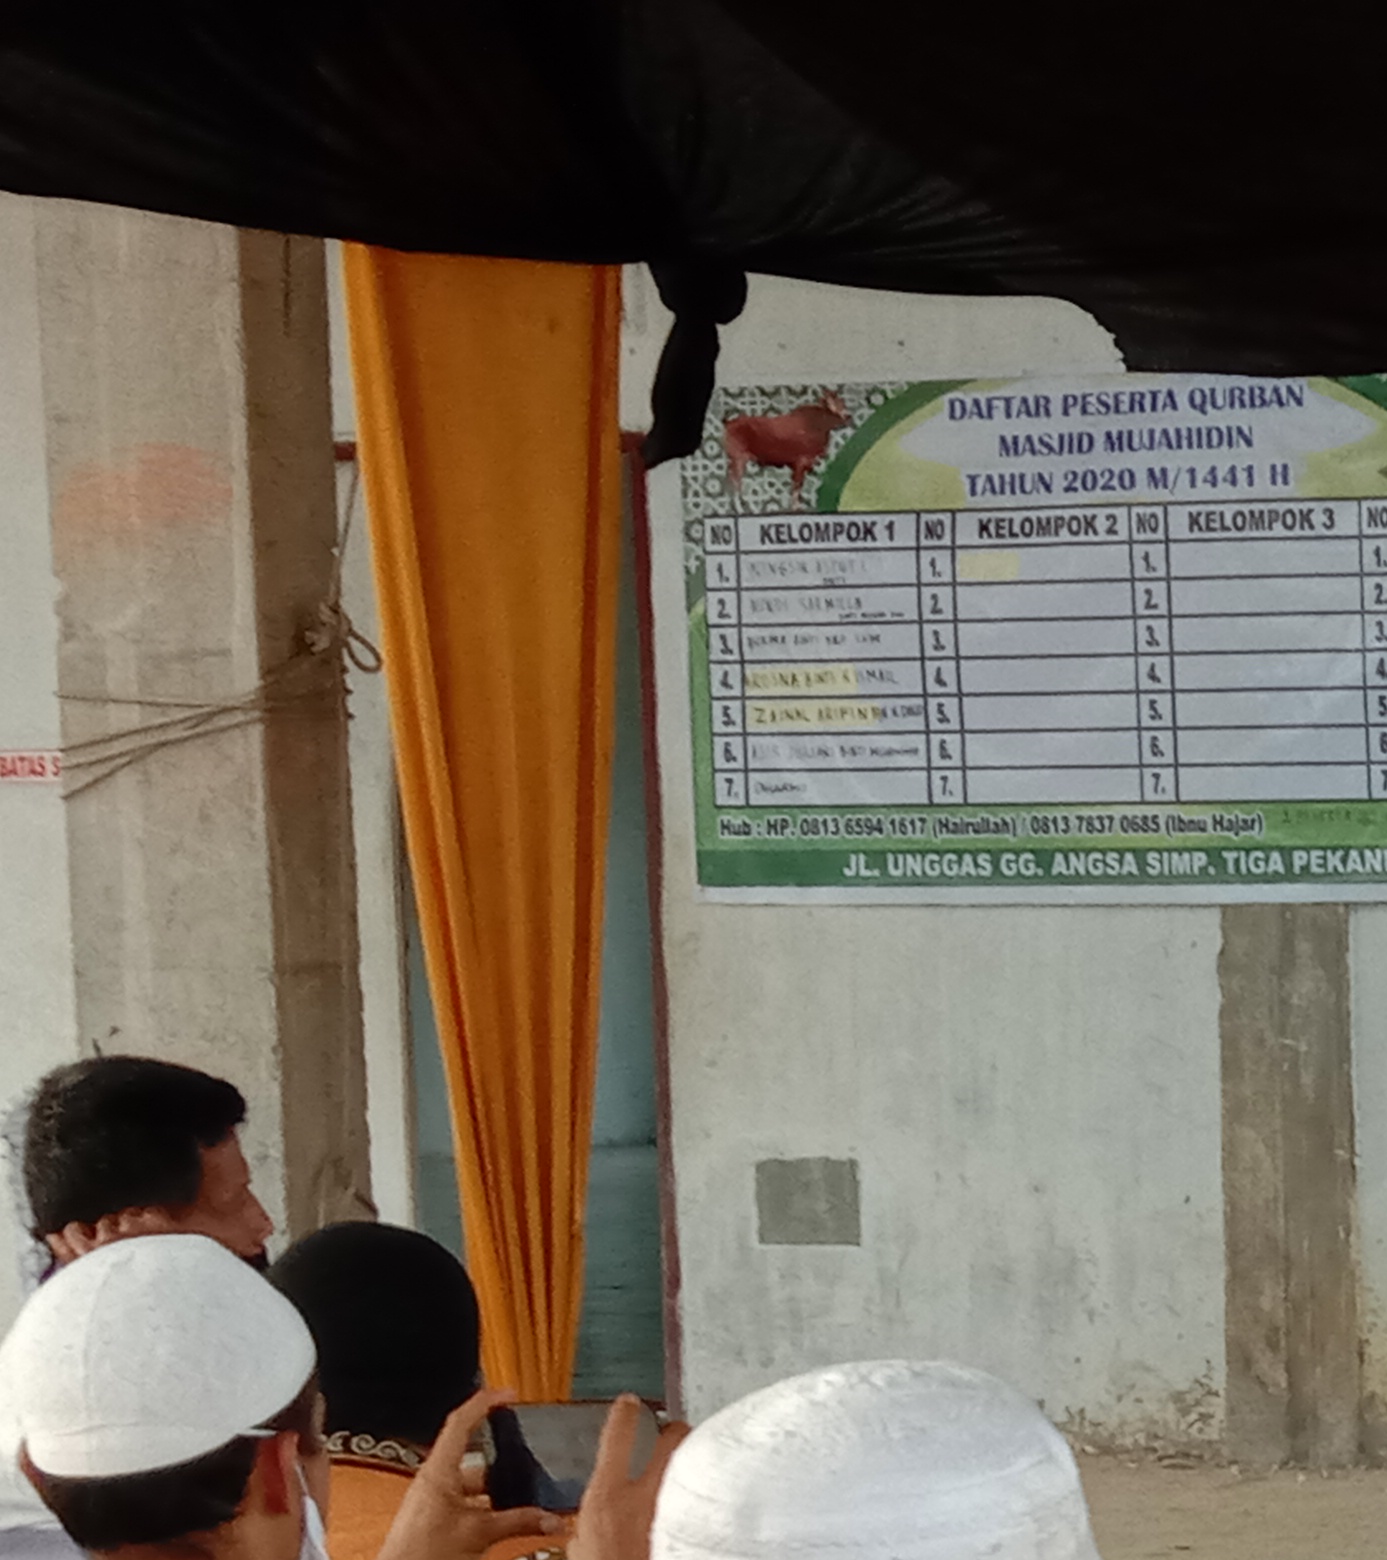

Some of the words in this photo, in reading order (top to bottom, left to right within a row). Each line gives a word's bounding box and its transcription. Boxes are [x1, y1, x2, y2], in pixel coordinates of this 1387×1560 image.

[948, 395, 1051, 420] DAFTAR
[1062, 388, 1179, 416] PESERTA
[1188, 385, 1303, 412] QURBAN
[999, 432, 1094, 457] MASJID
[1104, 426, 1253, 455] MUJAHIDIN
[966, 472, 1053, 497] TAHUN
[1063, 467, 1135, 493] 2020
[1147, 464, 1255, 495] M/1441
[1270, 463, 1290, 486] H
[924, 519, 945, 542] NO
[978, 513, 1098, 539] KELOMPOK
[1105, 512, 1119, 535] 2
[1135, 512, 1159, 536] NO
[1188, 509, 1315, 533] KELOMPOK
[1322, 508, 1336, 529] 3
[711, 524, 732, 545] NO
[760, 520, 878, 545] KELOMPOK
[885, 520, 895, 541] 1
[929, 557, 942, 578] 1.
[1142, 551, 1156, 573] 1.
[1373, 546, 1387, 568] 1.
[717, 562, 729, 582] 1.
[724, 778, 739, 798] 7.
[940, 775, 953, 796] 7.
[1151, 772, 1166, 795] 7.
[720, 817, 751, 837] Hub
[800, 815, 838, 836] 0813
[844, 816, 883, 836] 6594
[931, 815, 1016, 839] (Hairullah)
[1031, 814, 1070, 835] 0813
[1076, 814, 1114, 835] 7837
[1119, 814, 1159, 835] 0685
[1165, 813, 1207, 836] (Ibnu
[1212, 812, 1264, 838] Hajar)
[843, 853, 880, 877] JL.
[887, 852, 993, 877] UNGGAS
[1000, 853, 1044, 877] GG.
[1051, 851, 1139, 876] ANGSA
[1145, 851, 1215, 876] SIMP.
[1221, 850, 1285, 875] TIGA
